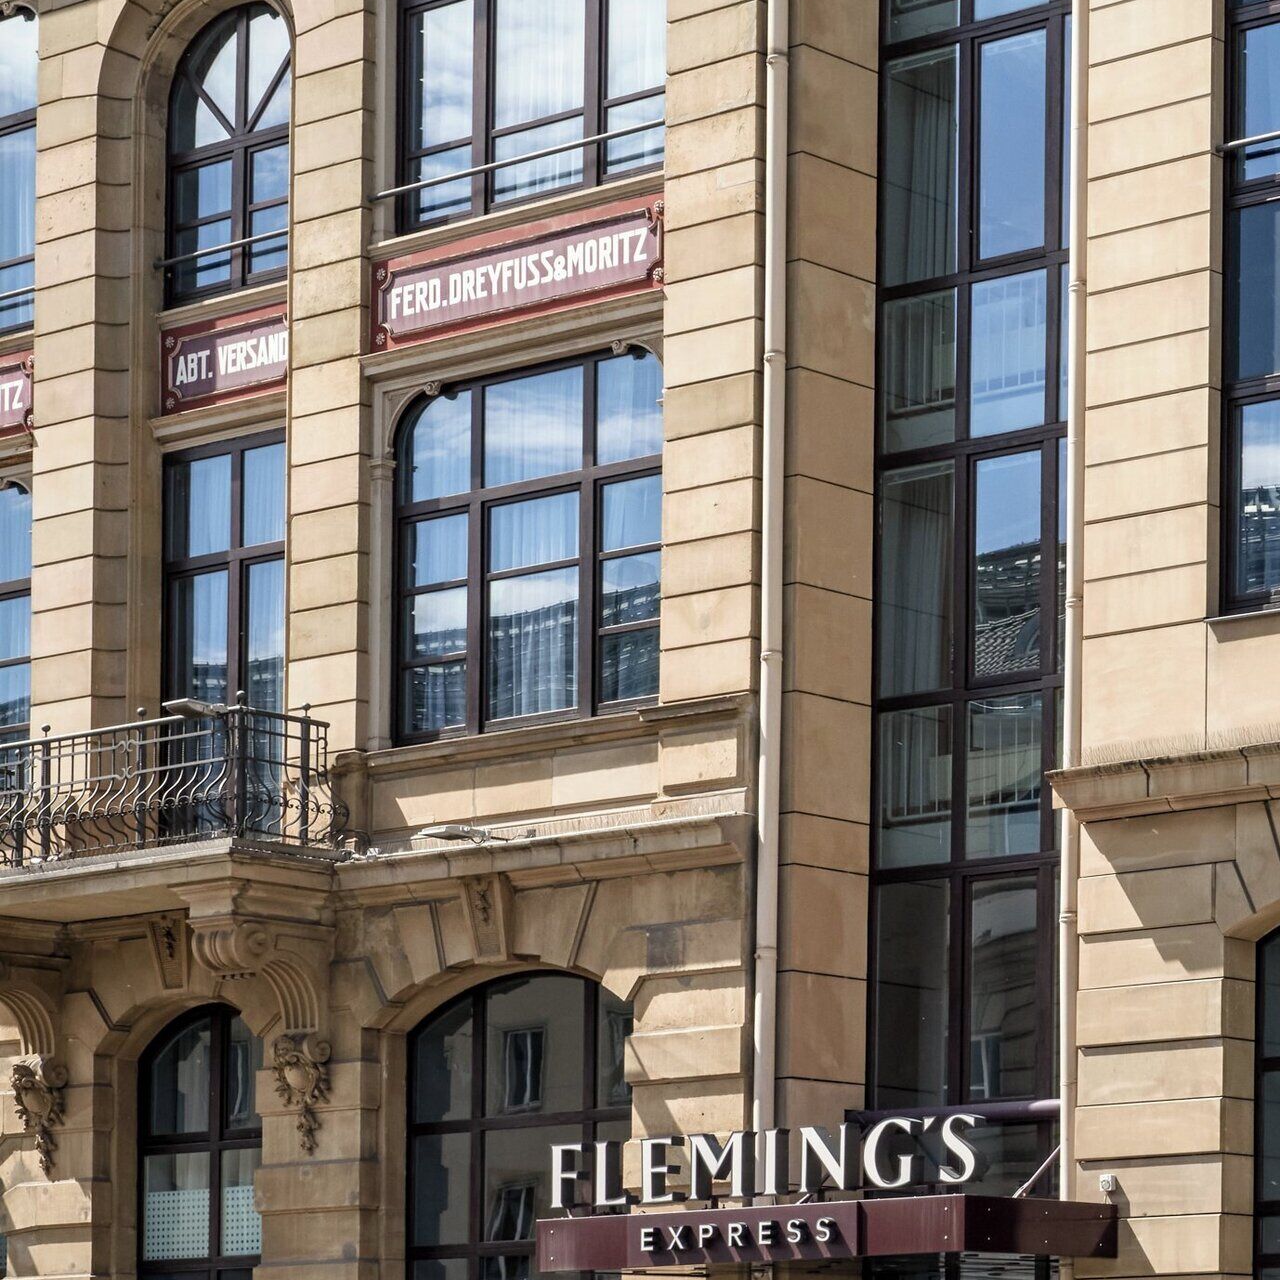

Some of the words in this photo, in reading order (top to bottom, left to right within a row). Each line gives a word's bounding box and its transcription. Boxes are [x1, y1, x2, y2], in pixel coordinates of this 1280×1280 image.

[175, 349, 213, 386] ABT.
[217, 330, 288, 375] VERSAND
[0, 379, 24, 412] TZ
[551, 1114, 977, 1209] FLEMING'S
[641, 1218, 832, 1252] EXPRESS
